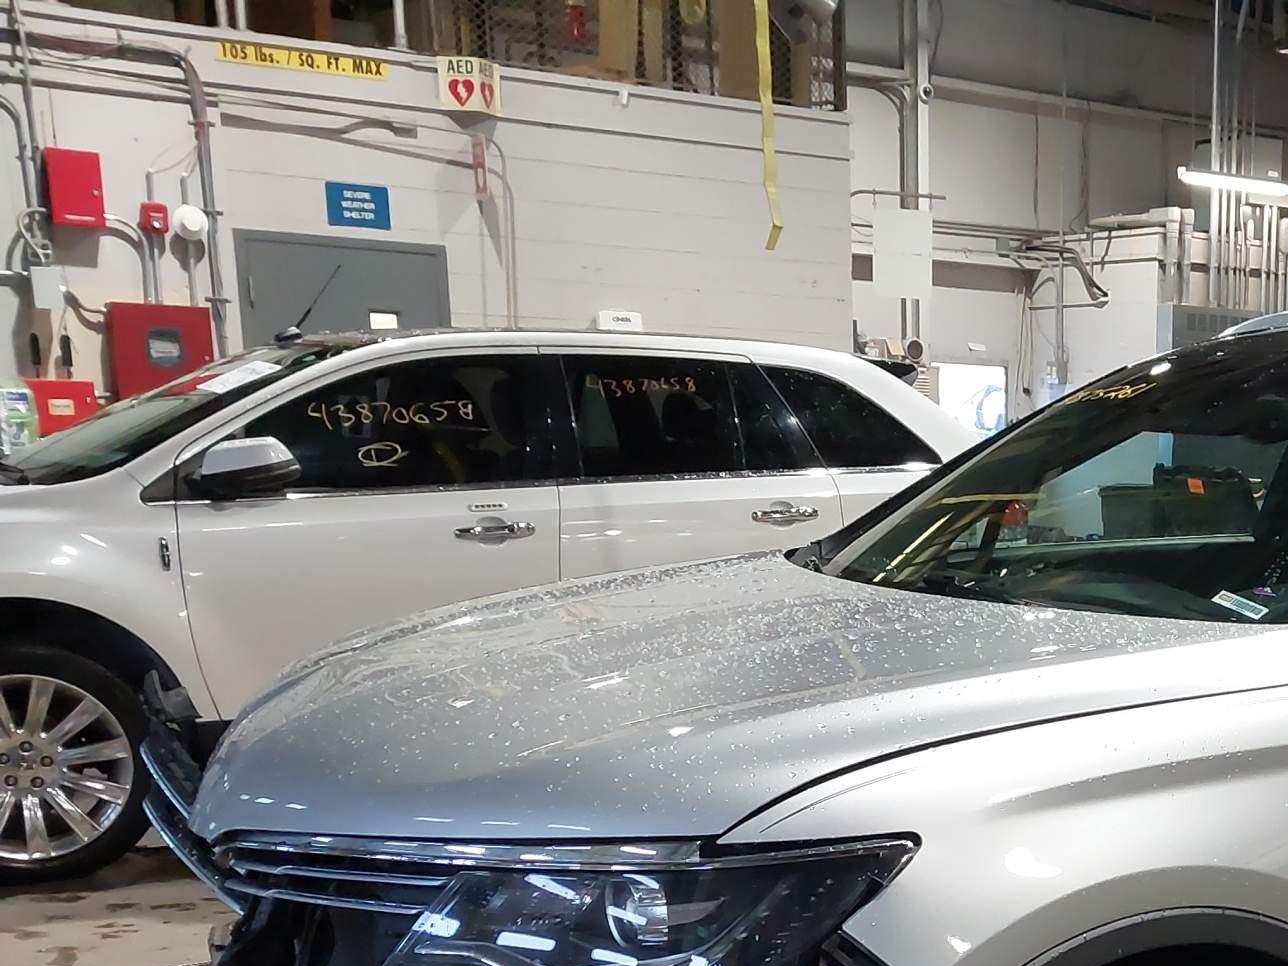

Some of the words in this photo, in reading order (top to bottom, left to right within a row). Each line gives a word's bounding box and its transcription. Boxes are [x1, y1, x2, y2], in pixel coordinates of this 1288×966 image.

[221, 43, 248, 60] 105
[254, 46, 280, 64] lbs.
[298, 53, 321, 69] SQ.
[326, 56, 346, 72] FT.
[352, 59, 383, 76] MAX
[447, 59, 474, 74] AED
[307, 400, 474, 431] 43870658
